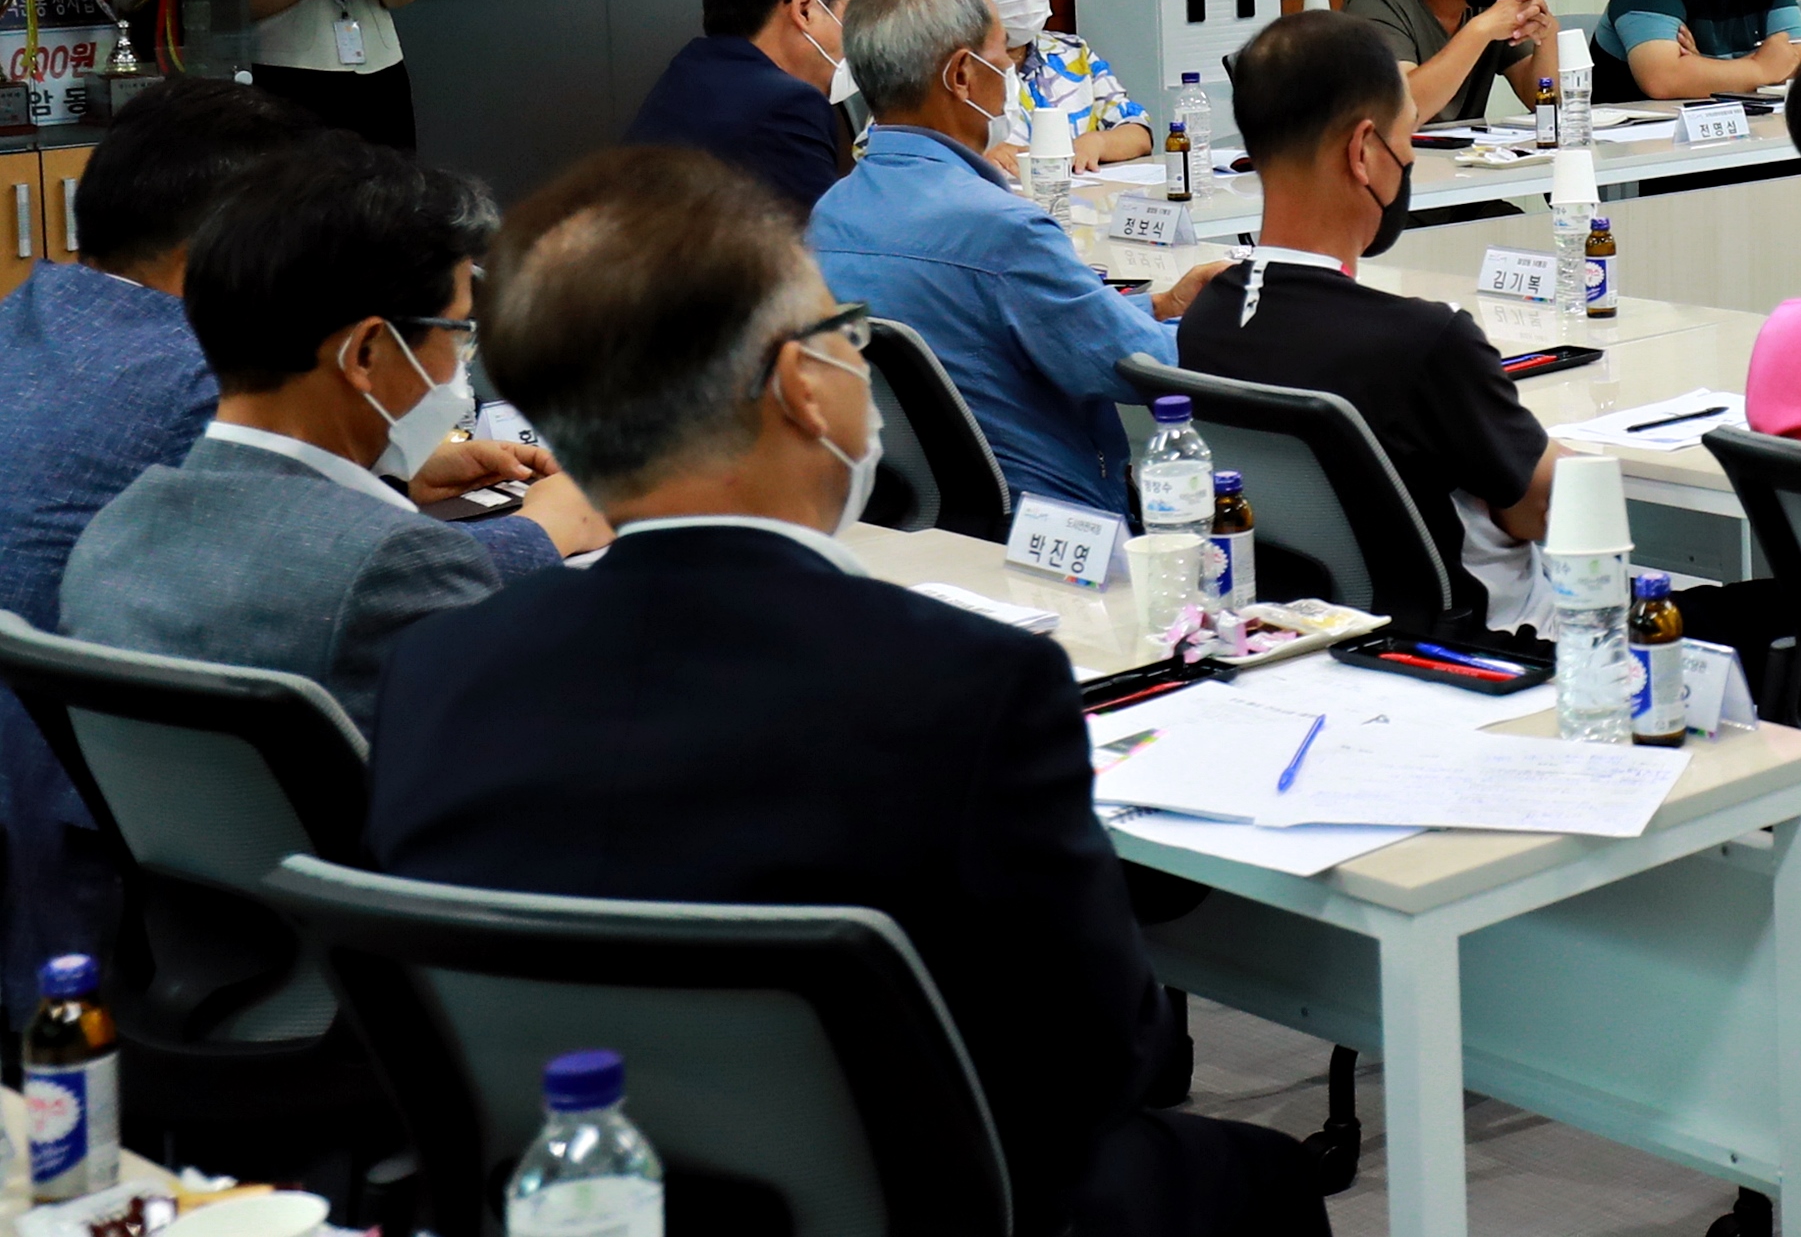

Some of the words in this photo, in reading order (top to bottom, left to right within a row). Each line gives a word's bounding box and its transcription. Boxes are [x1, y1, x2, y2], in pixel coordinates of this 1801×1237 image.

[1123, 217, 1164, 239] 정보식
[1493, 270, 1541, 295] 김기복
[1028, 533, 1091, 575] 박진영
